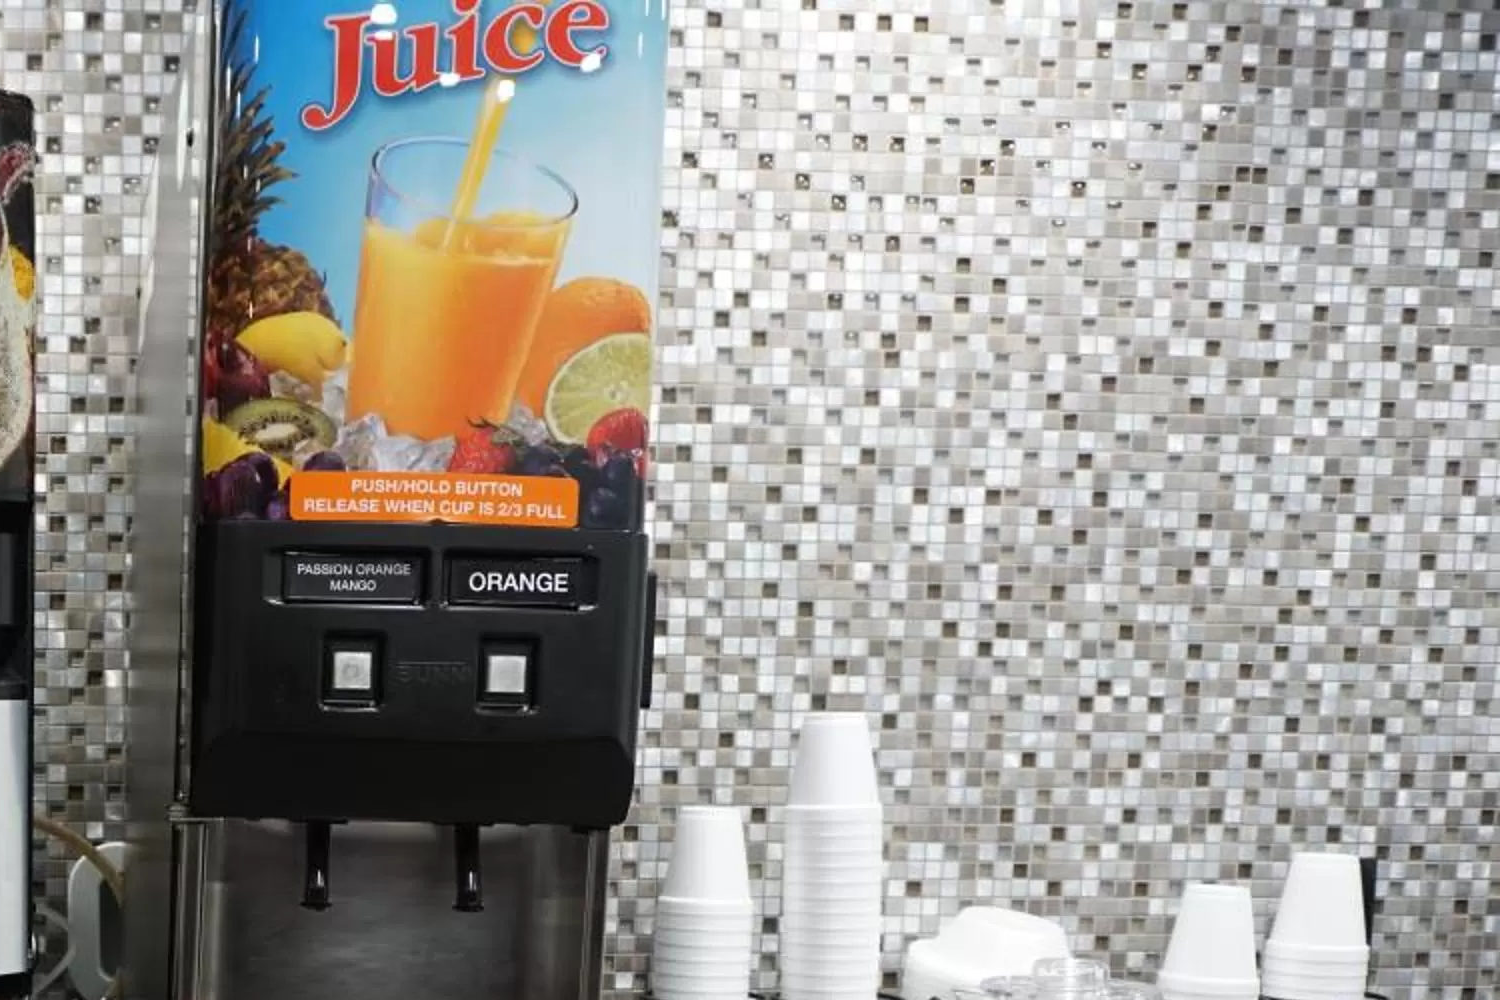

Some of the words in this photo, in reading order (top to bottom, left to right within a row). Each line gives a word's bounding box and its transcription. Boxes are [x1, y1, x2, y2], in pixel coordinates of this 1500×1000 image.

[301, 0, 610, 131] Juice
[351, 478, 451, 494] PUSH/HOLD
[455, 480, 524, 498] BUTTON
[303, 497, 380, 513] RELEASE
[385, 498, 435, 514] WHEN
[439, 499, 475, 514] CUP
[479, 501, 494, 515] IS
[498, 502, 523, 518] 2/3
[526, 503, 567, 520] FULL
[297, 563, 352, 576] PASSION
[355, 563, 412, 576] ORANGE
[329, 579, 377, 592] MANGO
[468, 572, 570, 594] ORANGE
